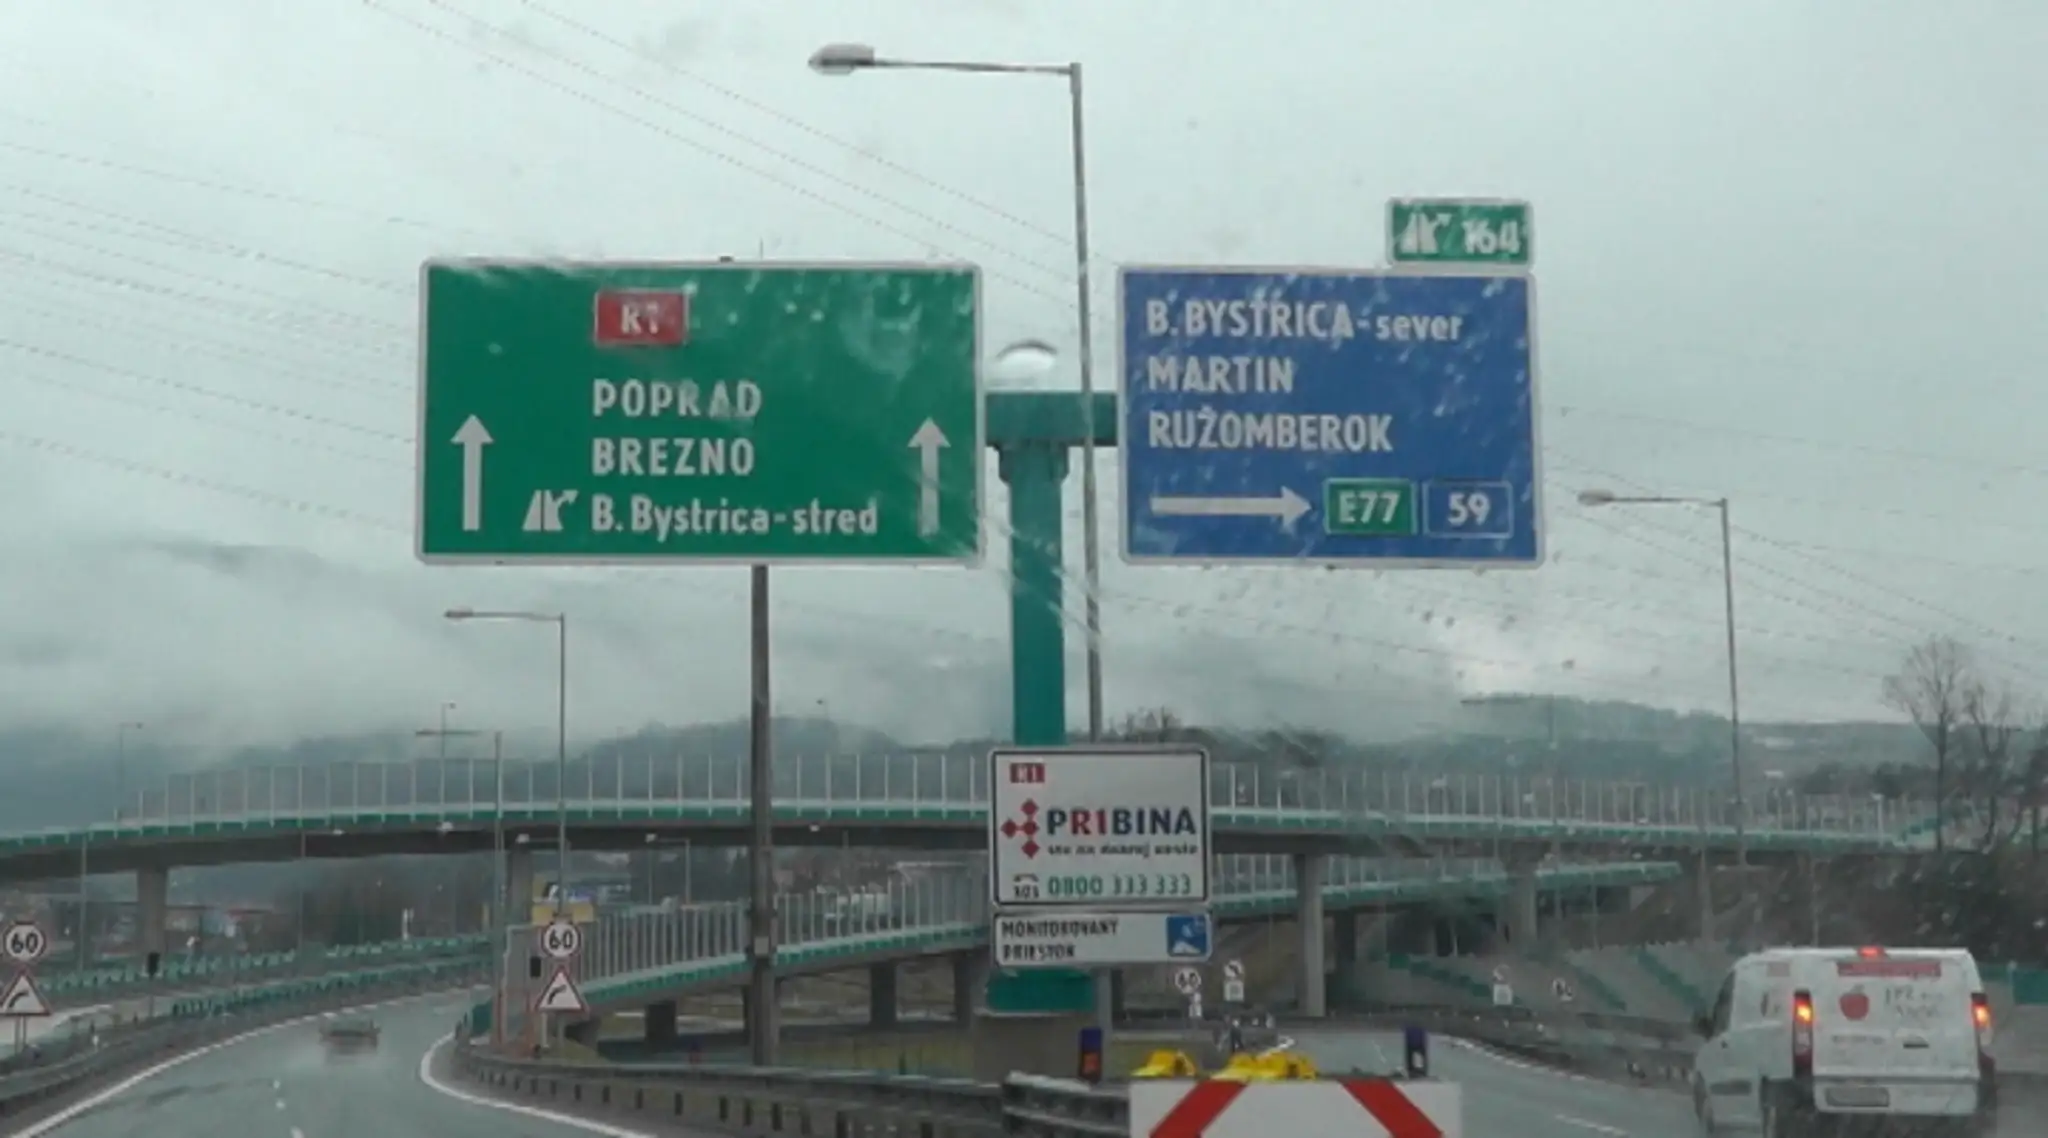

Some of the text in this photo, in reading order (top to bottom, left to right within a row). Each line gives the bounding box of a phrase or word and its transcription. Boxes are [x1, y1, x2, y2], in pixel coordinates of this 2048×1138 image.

[1461, 218, 1521, 254] 164
[1147, 355, 1294, 394] MARTIN
[592, 378, 763, 418] POPRAD
[1148, 407, 1394, 452] RUŽOMBEROK
[592, 437, 756, 476] BREZNO
[1338, 490, 1400, 525] E77
[1448, 493, 1491, 528] 59
[12, 932, 39, 954] 60
[549, 929, 574, 950] 60
